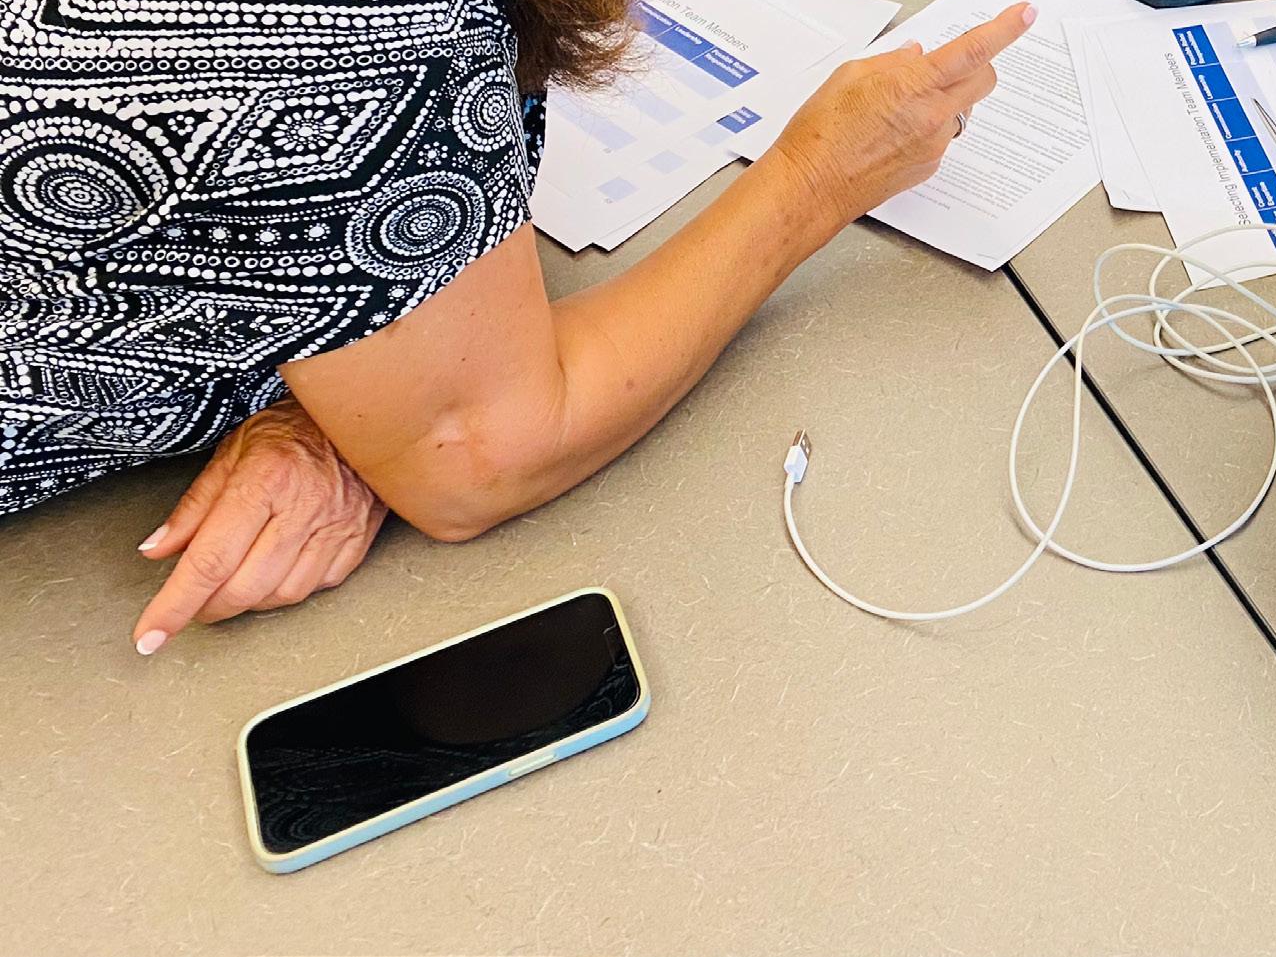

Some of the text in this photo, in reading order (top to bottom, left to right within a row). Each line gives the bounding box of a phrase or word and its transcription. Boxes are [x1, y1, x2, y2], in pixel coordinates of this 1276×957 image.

[680, 4, 707, 27] Team
[705, 21, 749, 52] Members
[1164, 52, 1252, 226] Selecting Implementation Team Members
